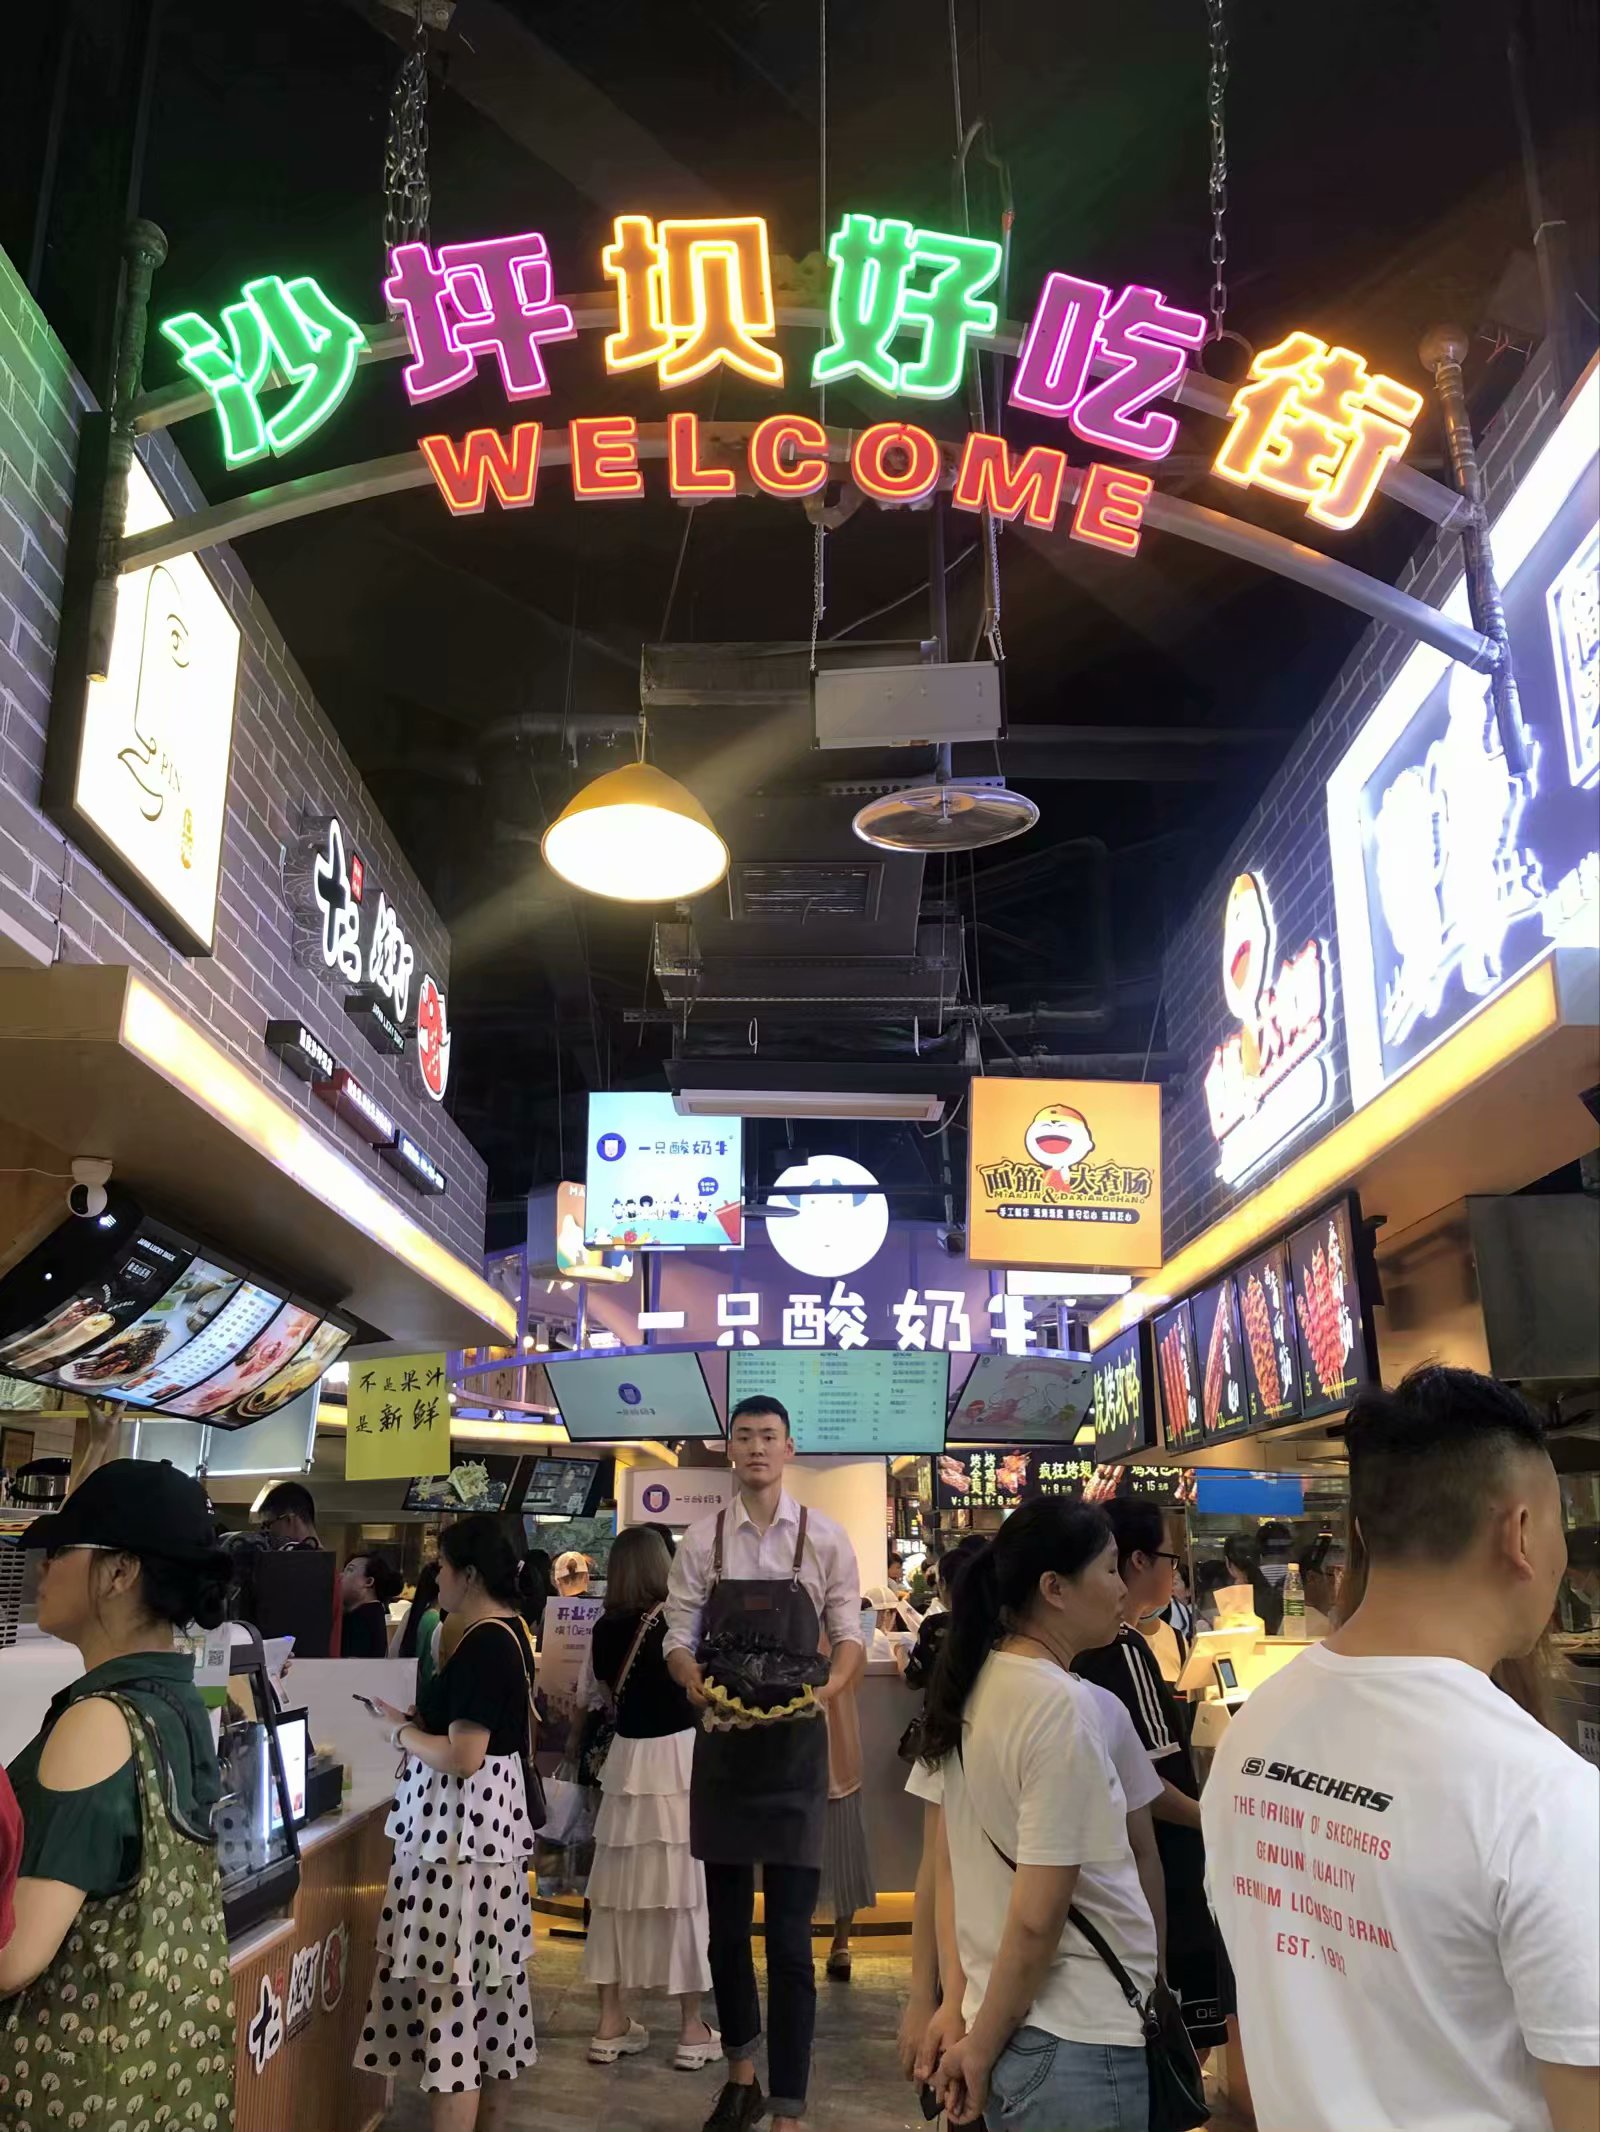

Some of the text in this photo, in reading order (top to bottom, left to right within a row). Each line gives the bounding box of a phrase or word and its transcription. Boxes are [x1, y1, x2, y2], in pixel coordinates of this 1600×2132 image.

[160, 212, 1425, 532] 沙坪坝好吃街
[418, 411, 1154, 557] WELCOME
[639, 1139, 728, 1156] 一只酸奶牛
[982, 1162, 1150, 1197] 面筋 大香肠
[638, 1280, 1037, 1355] 一只酸奶牛
[360, 1367, 444, 1393] 不是果汁
[356, 1397, 439, 1433] 是新鲜
[1265, 1762, 1394, 1812] SKECHERS
[1233, 1795, 1256, 1817] THE
[1260, 1801, 1305, 1829] ORIGIN
[1326, 1820, 1392, 1861] SKECHERS
[1276, 1932, 1316, 1959] EST.
